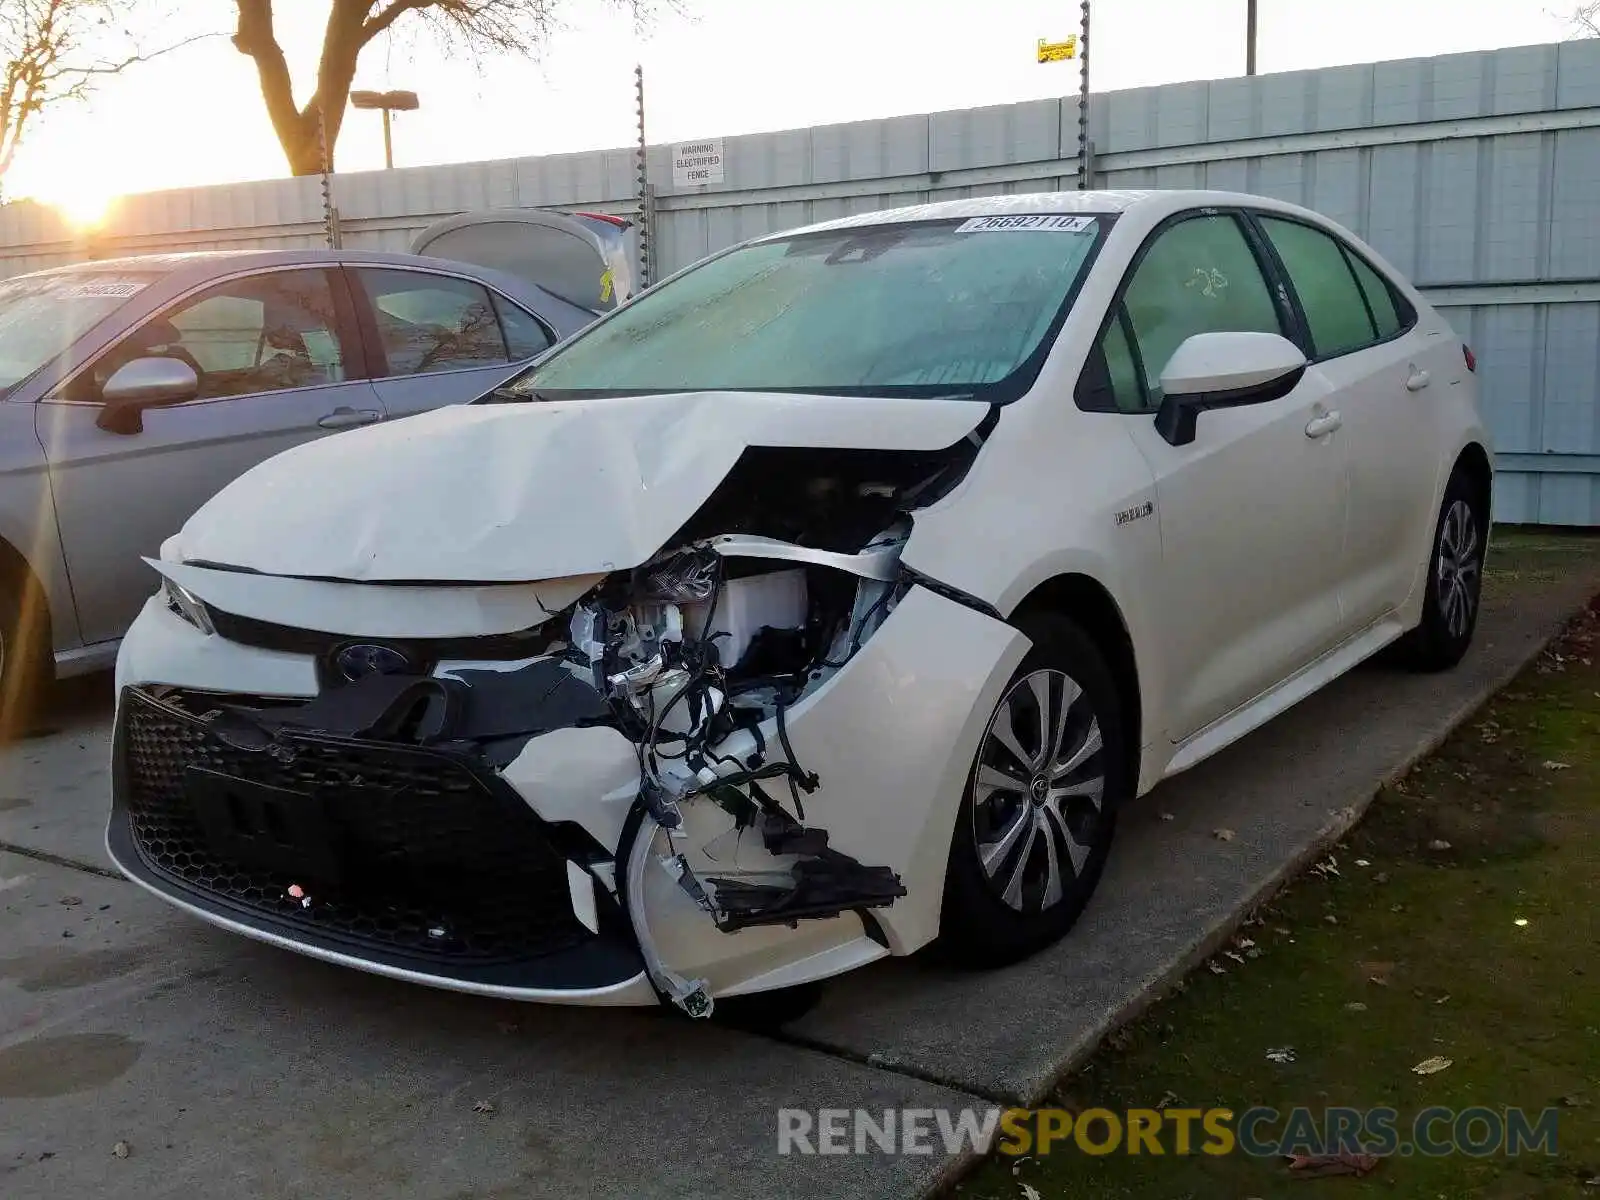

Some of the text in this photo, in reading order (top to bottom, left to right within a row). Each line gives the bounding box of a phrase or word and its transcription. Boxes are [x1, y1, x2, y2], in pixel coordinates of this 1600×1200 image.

[681, 144, 713, 156] WARNING
[676, 156, 719, 168] ELECTRIFIED
[687, 170, 709, 179] FENCE
